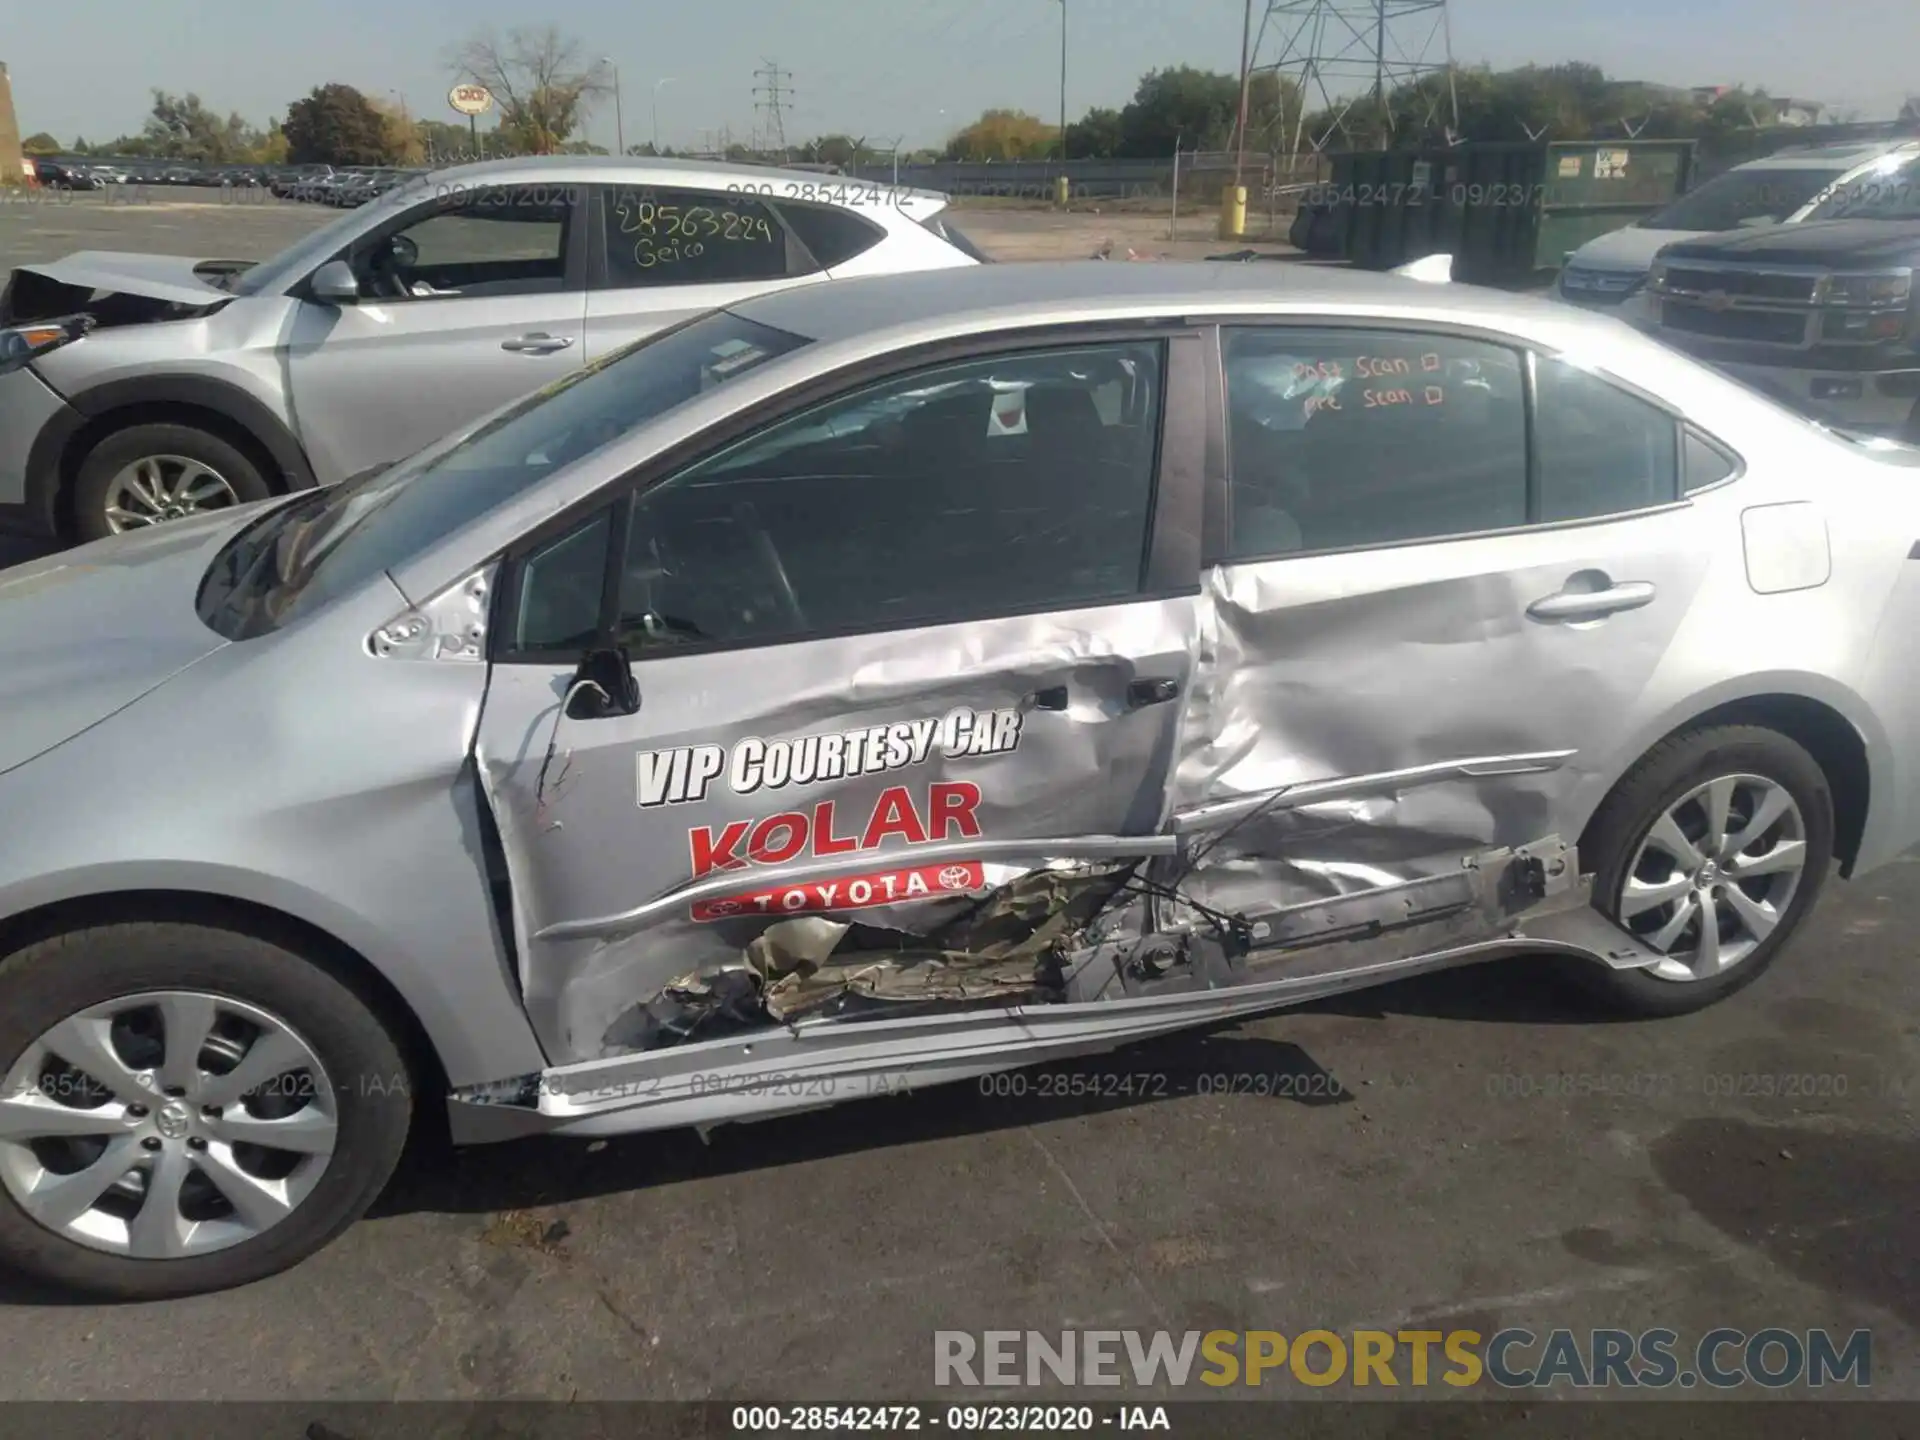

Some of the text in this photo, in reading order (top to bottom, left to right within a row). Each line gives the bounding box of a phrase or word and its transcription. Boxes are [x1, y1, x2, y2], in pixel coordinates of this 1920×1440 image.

[634, 238, 704, 267] Geico
[637, 704, 1024, 808] VIP COURTESY CAR
[689, 780, 983, 878] KOLAR
[754, 871, 929, 913] TOYOTA
